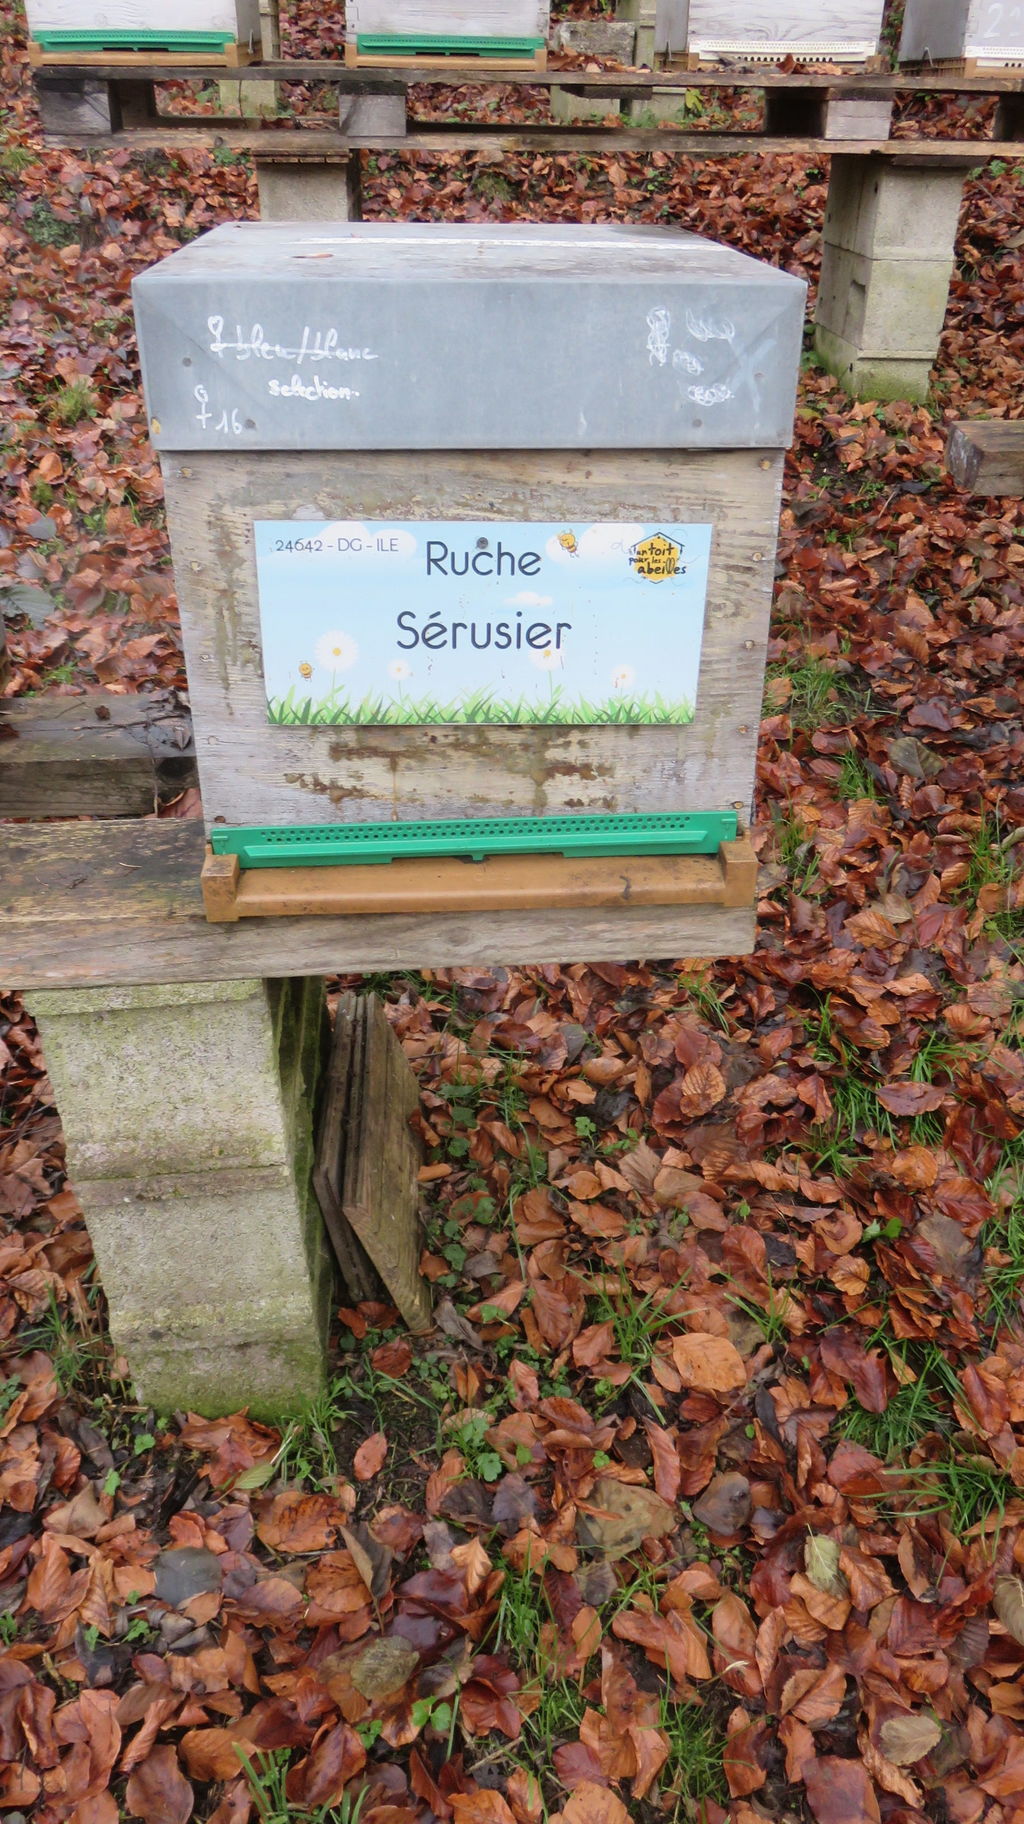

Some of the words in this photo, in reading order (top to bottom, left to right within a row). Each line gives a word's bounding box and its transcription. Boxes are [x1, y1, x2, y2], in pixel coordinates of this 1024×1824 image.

[275, 538, 323, 552] 24642
[648, 542, 675, 556] toit
[426, 541, 541, 576] Ruche
[637, 557, 687, 575] abeilles
[397, 610, 572, 649] Sérusier
